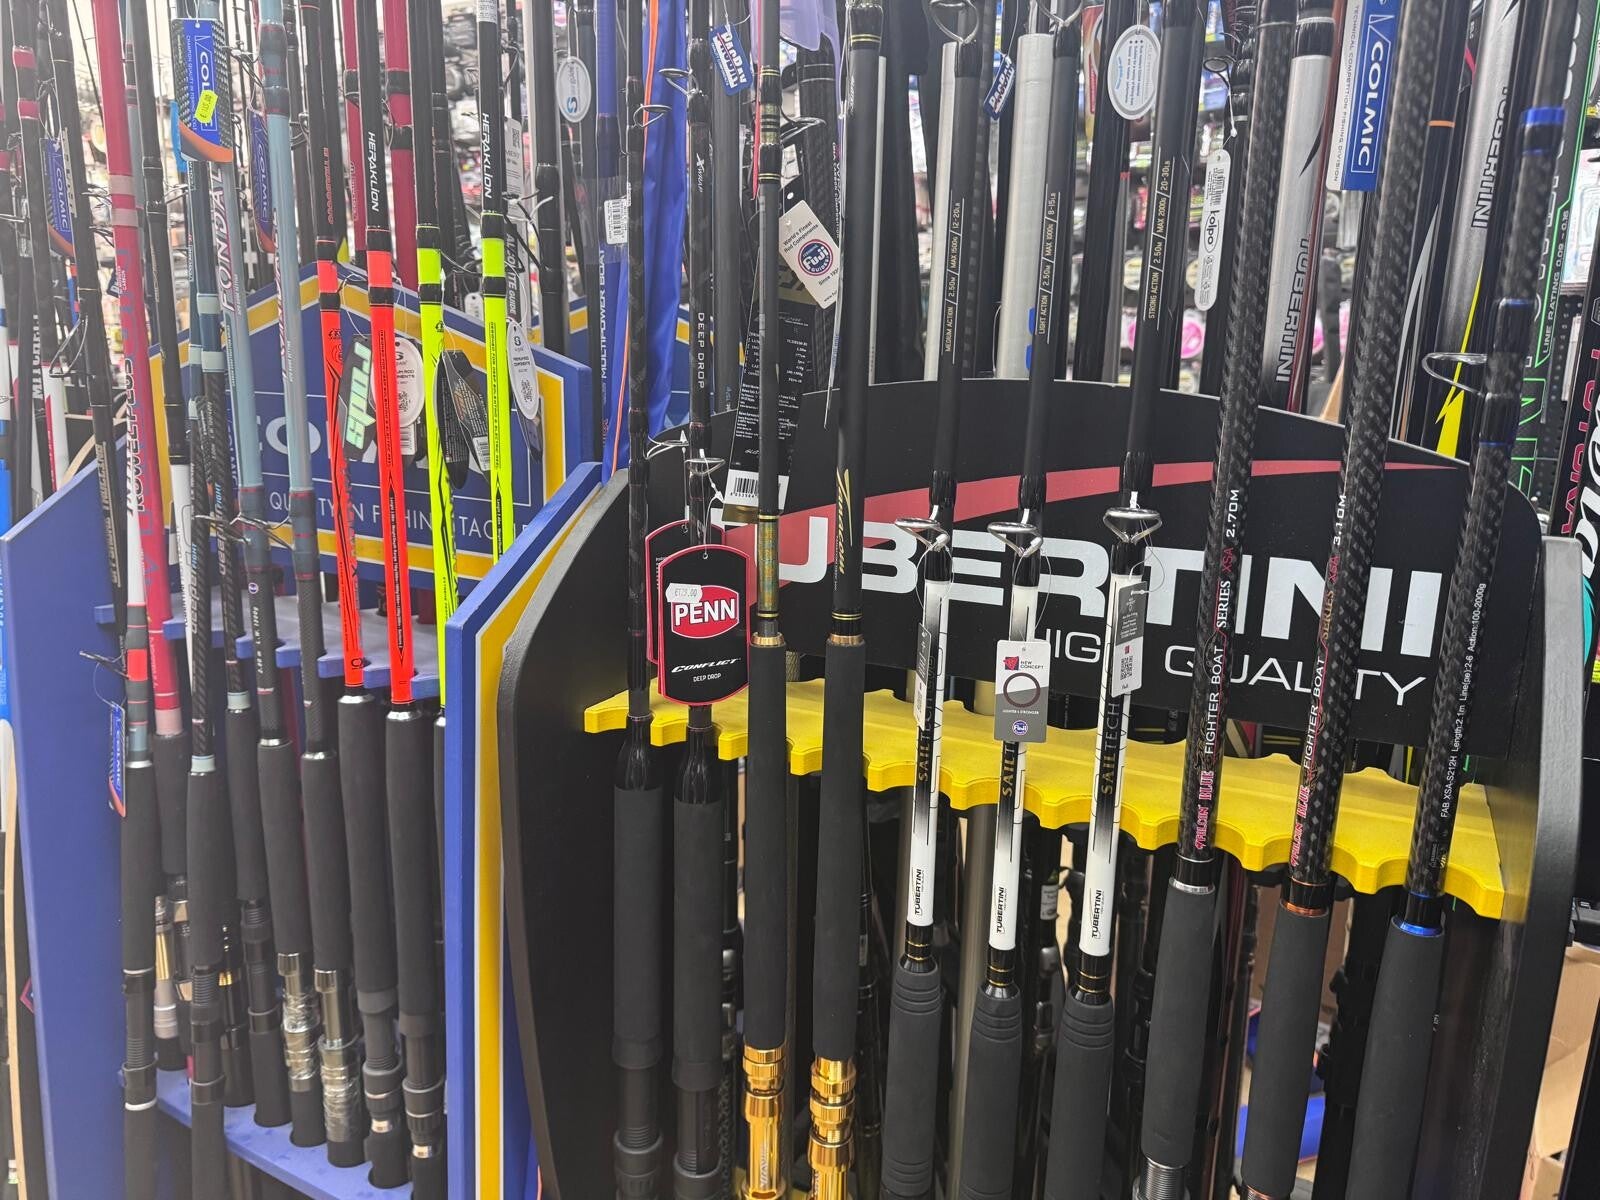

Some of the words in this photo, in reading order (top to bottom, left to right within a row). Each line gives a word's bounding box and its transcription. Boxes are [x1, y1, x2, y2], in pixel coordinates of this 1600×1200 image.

[1358, 41, 1384, 167] COLMIC
[258, 143, 269, 219] COLMIC
[1333, 147, 1342, 183] DIVISION
[56, 167, 69, 229] COLMIC
[1156, 218, 1164, 234] MAX
[1207, 209, 1220, 246] kolpo
[1045, 240, 1053, 256] MAX
[508, 290, 517, 314] GUIDE
[1040, 294, 1048, 312] ACTION
[1151, 271, 1160, 293] ACTION
[1039, 314, 1047, 334] LIGHT
[1148, 294, 1158, 319] STRONG
[1542, 324, 1552, 354] LINE
[1547, 271, 1560, 320] RATING
[600, 289, 608, 379] MULTIPOWER
[697, 312, 705, 348] DEEP
[697, 352, 705, 389] DROP
[213, 482, 223, 509] FIGHT
[1226, 489, 1240, 538] 2.70M
[1333, 493, 1347, 546] 3.10M
[190, 542, 199, 569] FIGHT
[1221, 547, 1234, 573] XSA
[1328, 555, 1340, 584] XSA
[711, 506, 1443, 659] UBERTINI
[674, 597, 736, 627] PENN
[1216, 579, 1232, 629] SERIES
[1322, 589, 1335, 641] SERIES
[1468, 582, 1487, 653] Action:100-2000g
[671, 659, 741, 674] CONFLICT
[693, 672, 706, 682] DEEP
[706, 672, 722, 681] DROP
[1211, 645, 1226, 685] BOAT
[1312, 655, 1326, 697] BOAT
[1462, 654, 1475, 702] Line(pe):2-6
[1205, 693, 1220, 754] FIGHTER
[1303, 704, 1319, 770] FIGHTER
[1454, 703, 1467, 752] Length:2.1m
[1101, 701, 1119, 796] SAILTECH
[1443, 755, 1457, 799] XSA-S212H
[1440, 799, 1450, 818] FAB
[914, 868, 923, 916] TUBERTINI
[996, 886, 1005, 934] TUBERTINI
[1091, 889, 1102, 938] TUBERTINI
